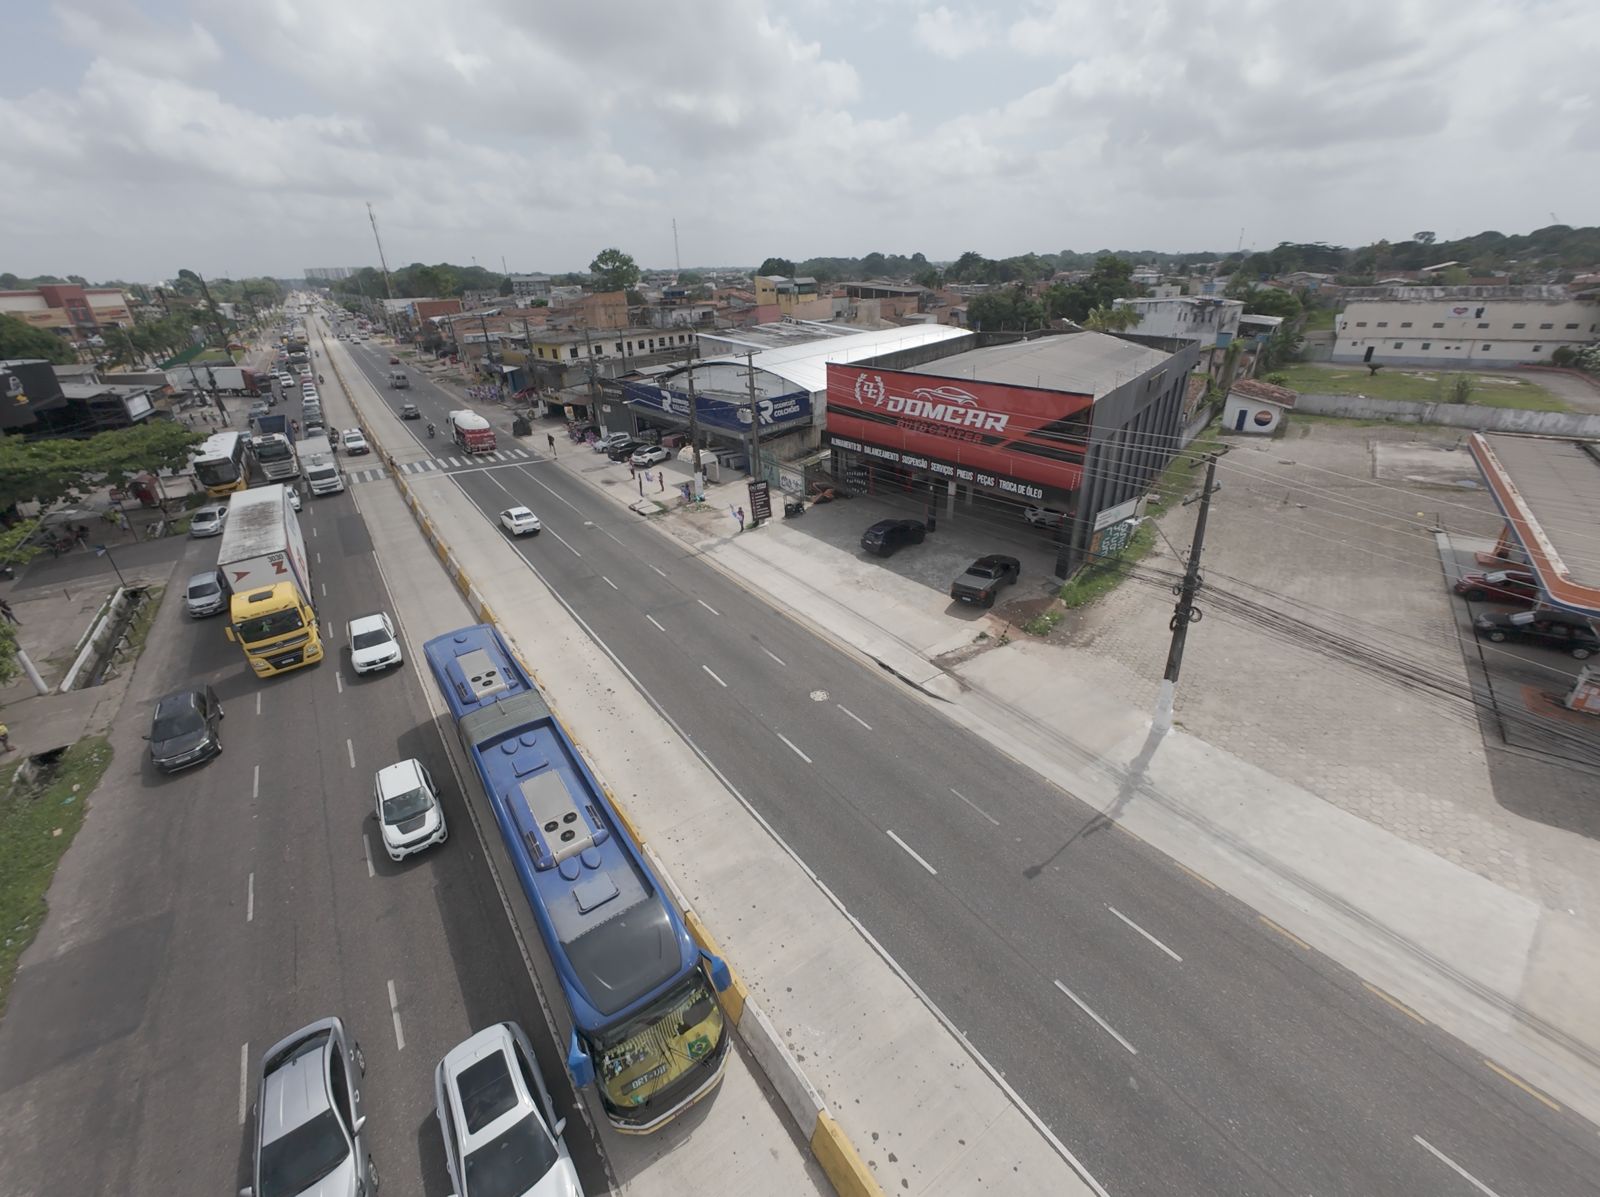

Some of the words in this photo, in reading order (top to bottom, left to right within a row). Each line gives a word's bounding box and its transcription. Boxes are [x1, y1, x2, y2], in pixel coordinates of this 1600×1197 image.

[758, 400, 774, 425] R
[773, 405, 800, 418] COLCHÕES
[886, 396, 1010, 432] DOMCAR
[864, 445, 900, 462] BALANCEAMENTO
[902, 455, 928, 469] SUSPENSÃO
[930, 462, 954, 476] SERVIÇOS
[956, 468, 974, 481] PNEUS
[976, 473, 995, 487] PEÇAS
[998, 479, 1017, 493] TROCA
[1017, 484, 1026, 495] DE
[1026, 484, 1043, 499] ÓLEO
